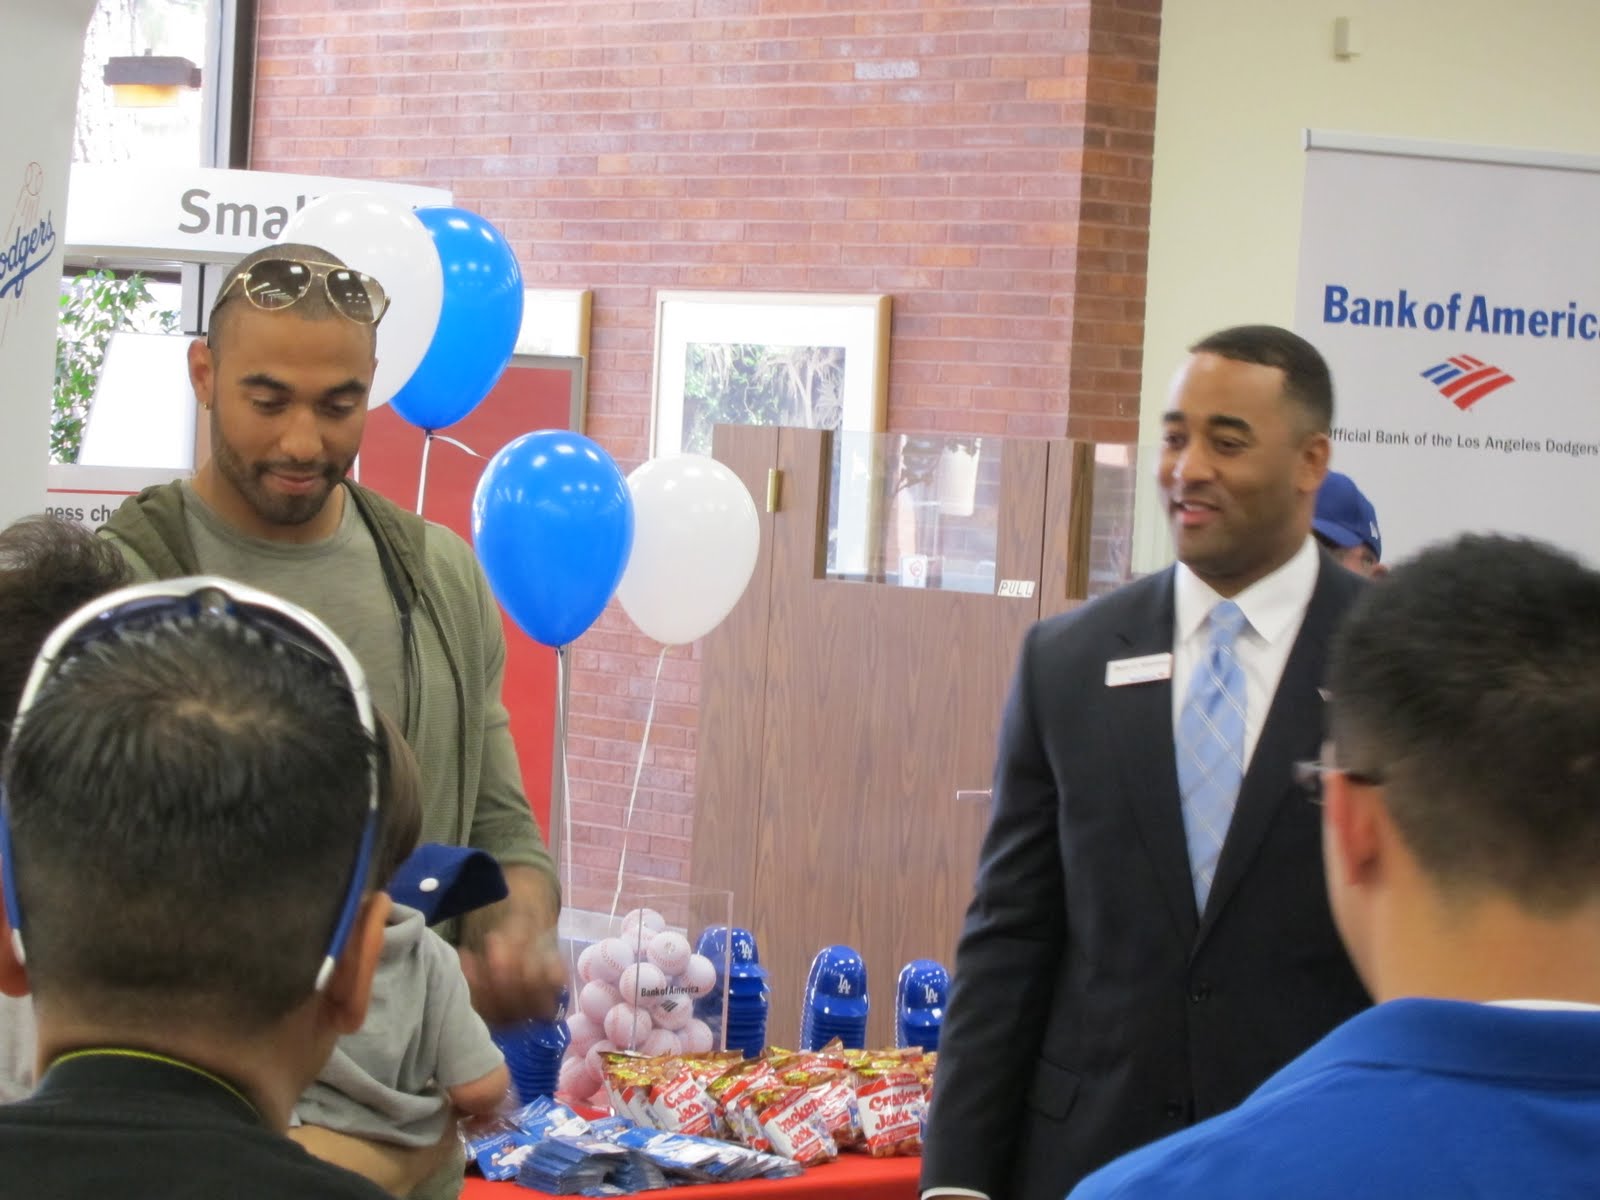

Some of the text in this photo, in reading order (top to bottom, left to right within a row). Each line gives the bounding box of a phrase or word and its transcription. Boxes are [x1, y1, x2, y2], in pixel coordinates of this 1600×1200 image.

[178, 188, 320, 240] Sma
[1323, 285, 1600, 340] Bank of Americ
[1376, 429, 1409, 445] Bank
[1414, 432, 1427, 446] of
[1432, 433, 1452, 448] the
[1457, 434, 1480, 449] Los
[1485, 436, 1541, 453] Angeles
[90, 504, 119, 522] ch
[1000, 582, 1032, 596] PULL
[739, 939, 753, 959] LA
[641, 985, 699, 997] Bank of America
[838, 974, 851, 994] LA
[924, 985, 938, 1003] LA
